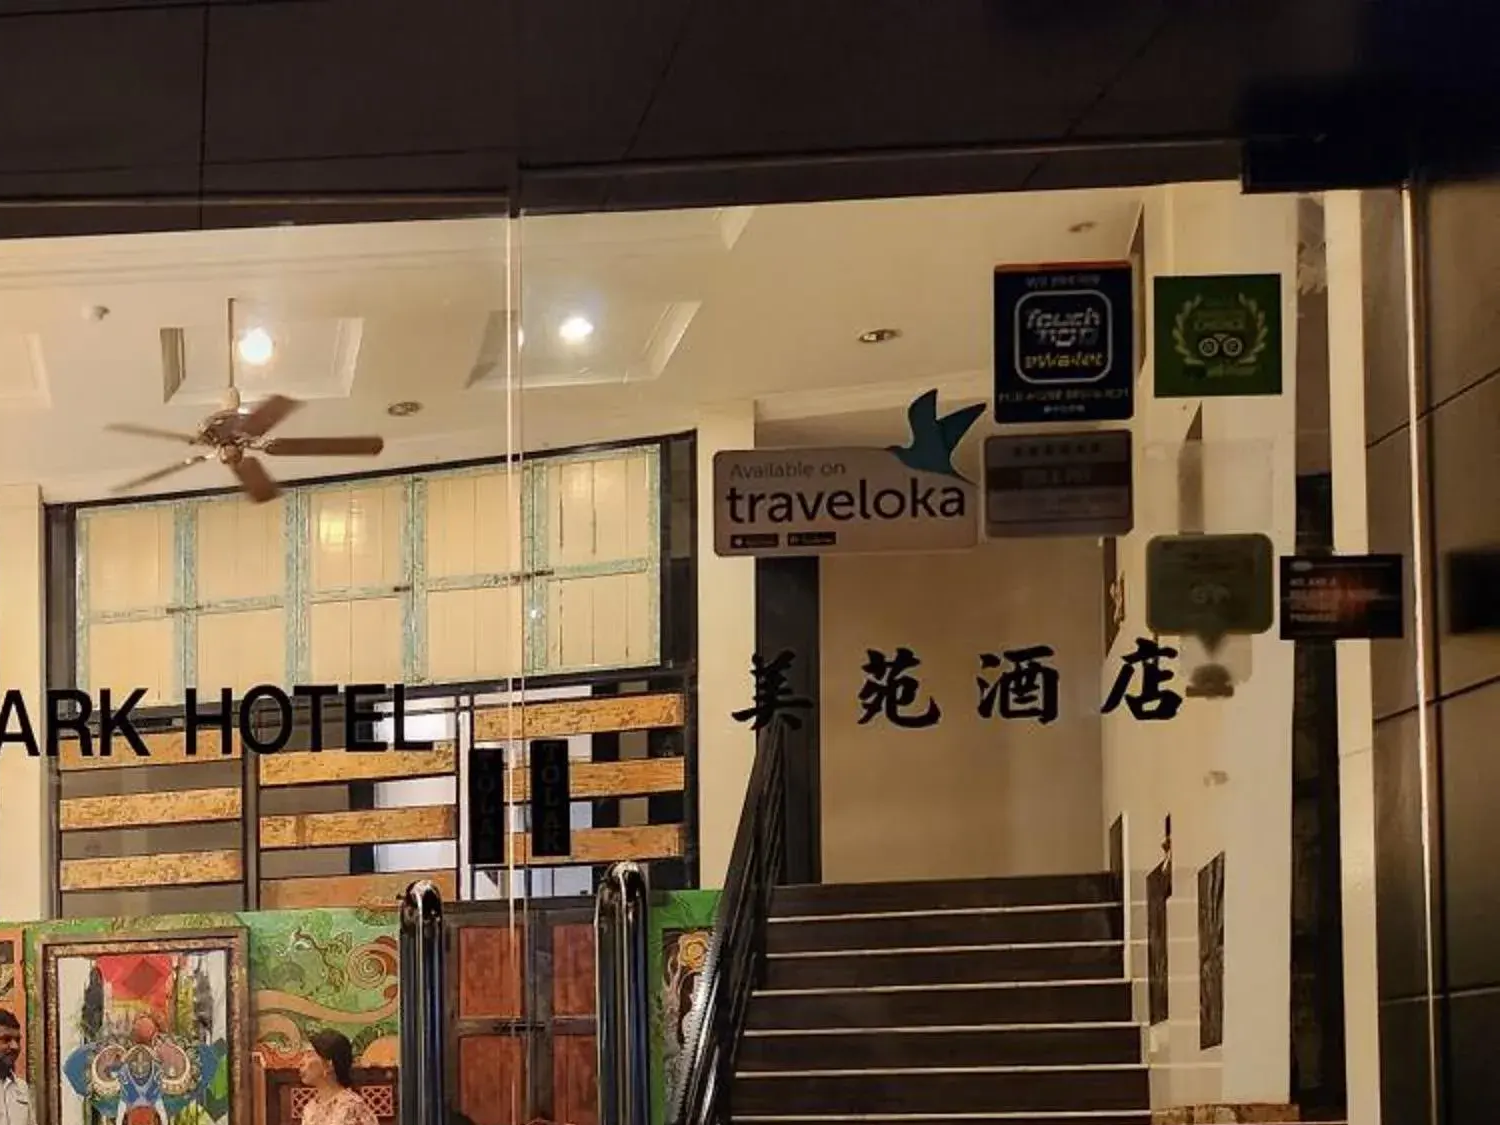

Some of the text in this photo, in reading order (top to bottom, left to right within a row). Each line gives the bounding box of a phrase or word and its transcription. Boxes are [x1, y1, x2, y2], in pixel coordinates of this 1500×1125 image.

[726, 477, 966, 524] traveloka
[730, 461, 846, 480] Available on
[185, 683, 433, 755] HOTEL
[731, 637, 1184, 731] 美苑酒店
[477, 751, 496, 859] TOLA
[541, 743, 561, 852] TOLAK
